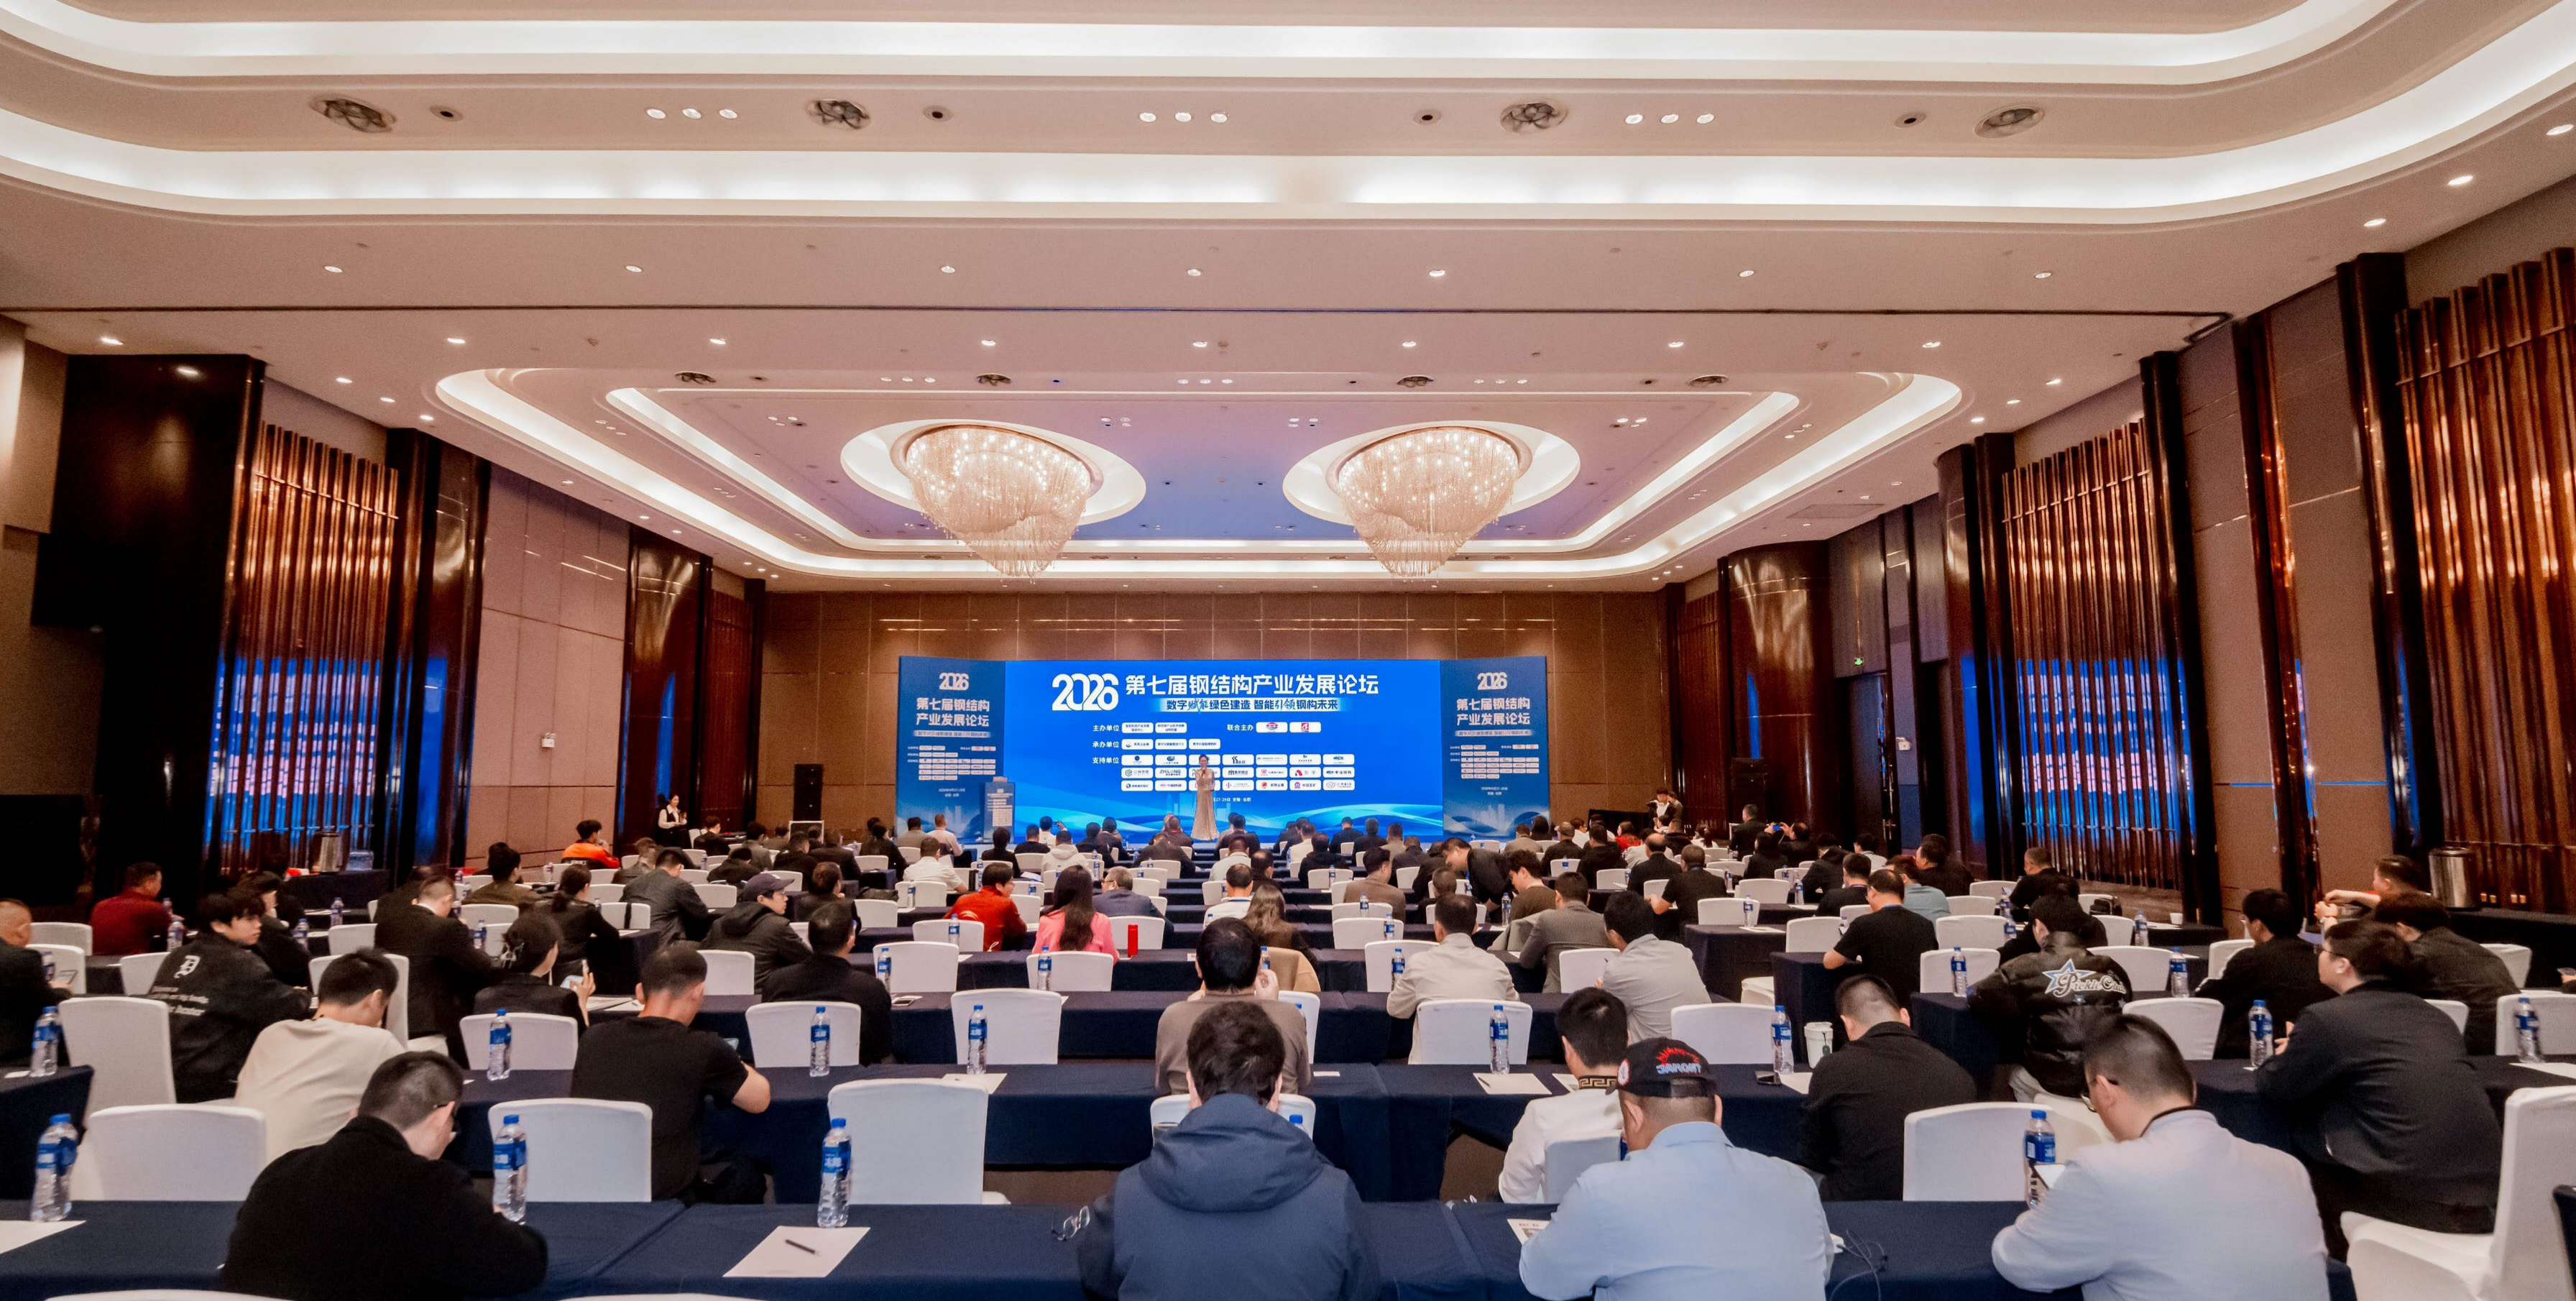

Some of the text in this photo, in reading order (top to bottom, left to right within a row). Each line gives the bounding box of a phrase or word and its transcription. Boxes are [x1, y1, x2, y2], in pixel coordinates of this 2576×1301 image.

[939, 673, 969, 690] 2026
[1477, 672, 1507, 690] 2026
[1052, 673, 1379, 711] 2026 第七届钢结构产业发展论坛
[916, 697, 990, 712] 第七届钢结构
[1167, 699, 1338, 711] 数字赋能绿色建造 智能引领钢构未来
[1456, 697, 1530, 711] 第七届钢结构
[916, 713, 989, 727] 产业发展论坛
[1457, 712, 1530, 726] 产业发展论坛
